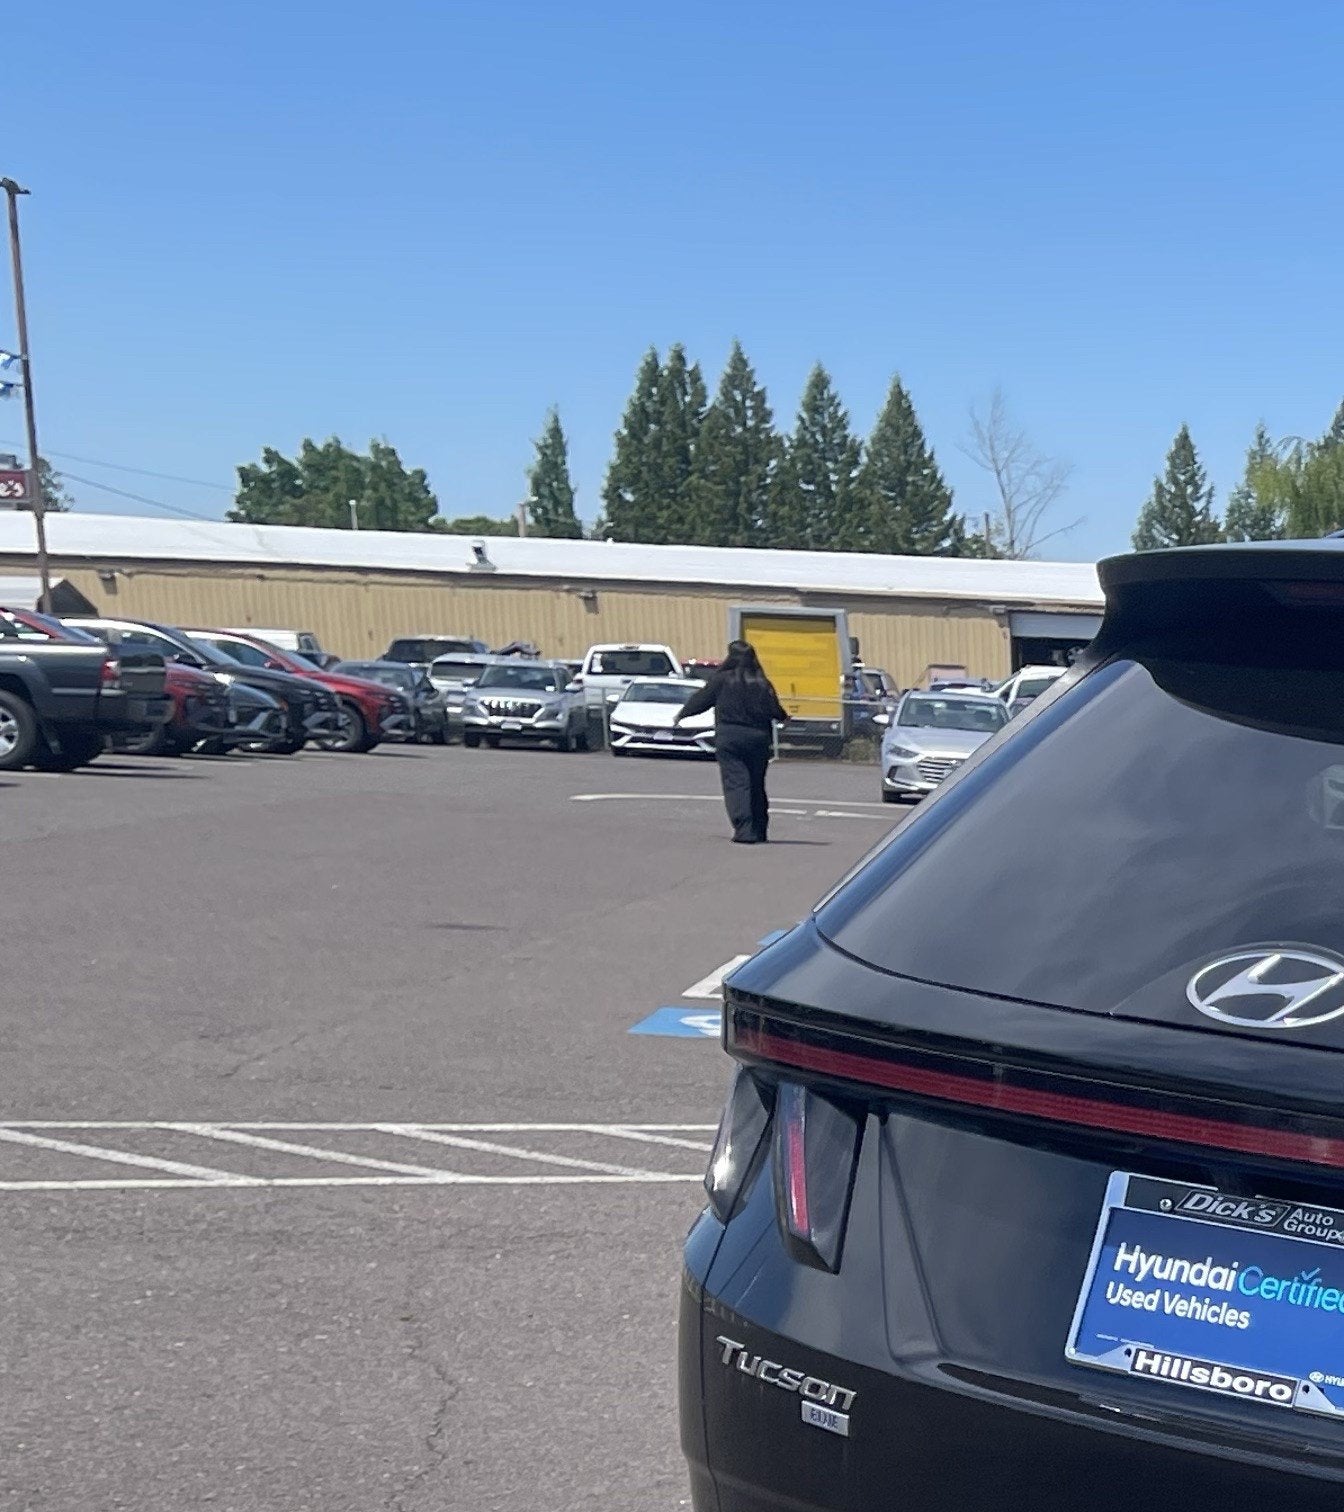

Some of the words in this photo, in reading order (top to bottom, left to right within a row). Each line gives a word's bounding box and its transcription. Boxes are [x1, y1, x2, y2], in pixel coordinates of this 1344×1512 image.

[1183, 1192, 1276, 1224] Dick's
[1290, 1208, 1334, 1227] Auto
[1283, 1218, 1341, 1241] Group
[1113, 1242, 1238, 1291] Hyundai
[1106, 1281, 1161, 1312] Used
[1163, 1291, 1251, 1329] Vehicles
[1135, 1350, 1292, 1401] Hillsboro
